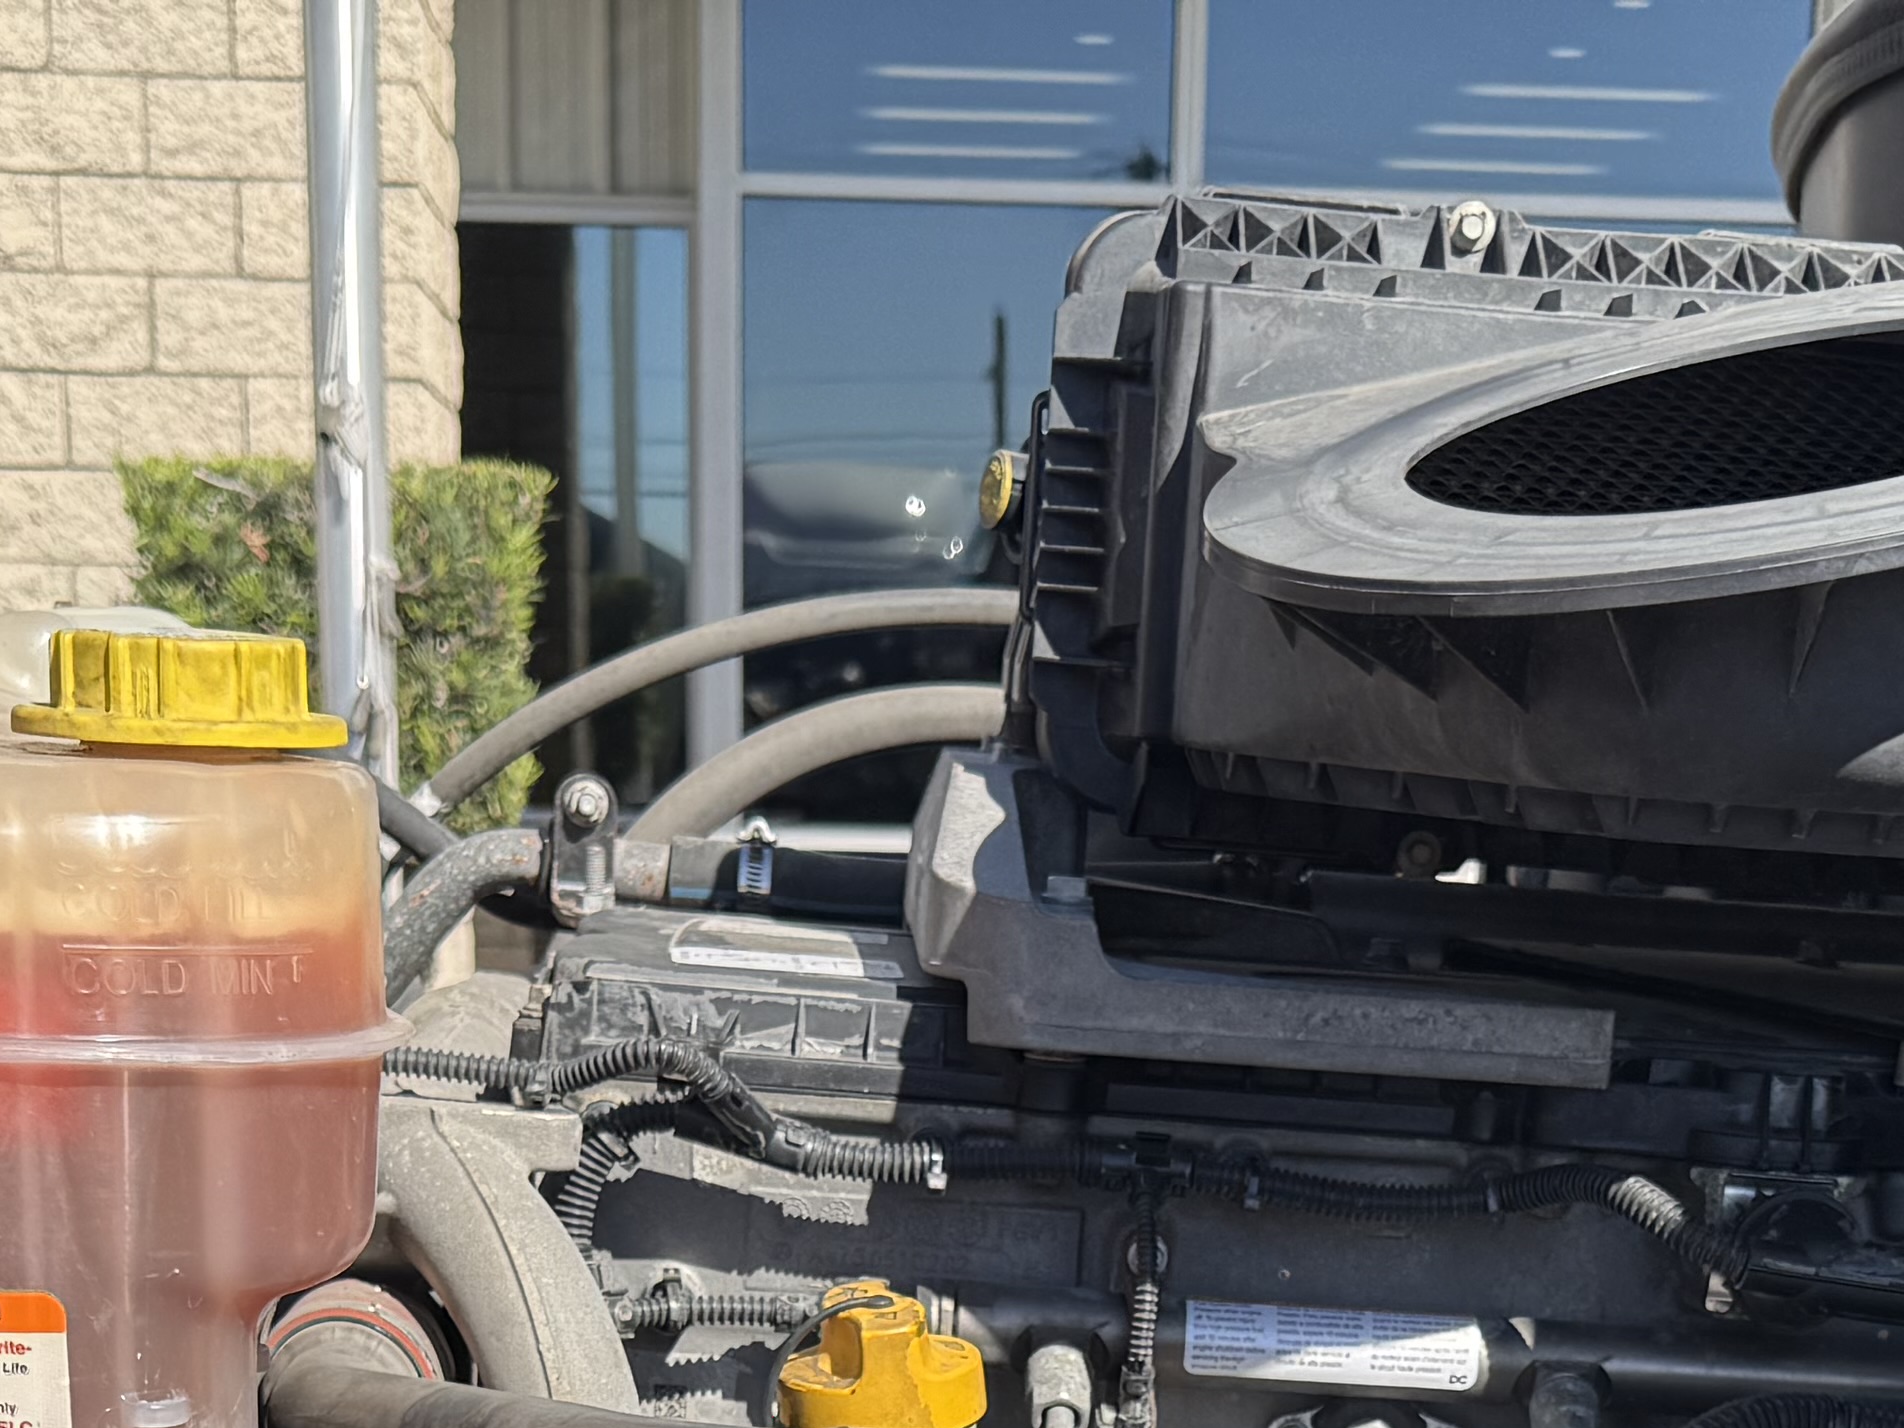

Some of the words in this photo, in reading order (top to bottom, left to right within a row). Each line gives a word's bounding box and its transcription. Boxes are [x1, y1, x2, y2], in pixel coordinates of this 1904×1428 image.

[71, 956, 186, 996] COLD
[211, 957, 273, 996] MIN
[2, 1363, 29, 1375] Life
[1449, 1374, 1468, 1385] DC
